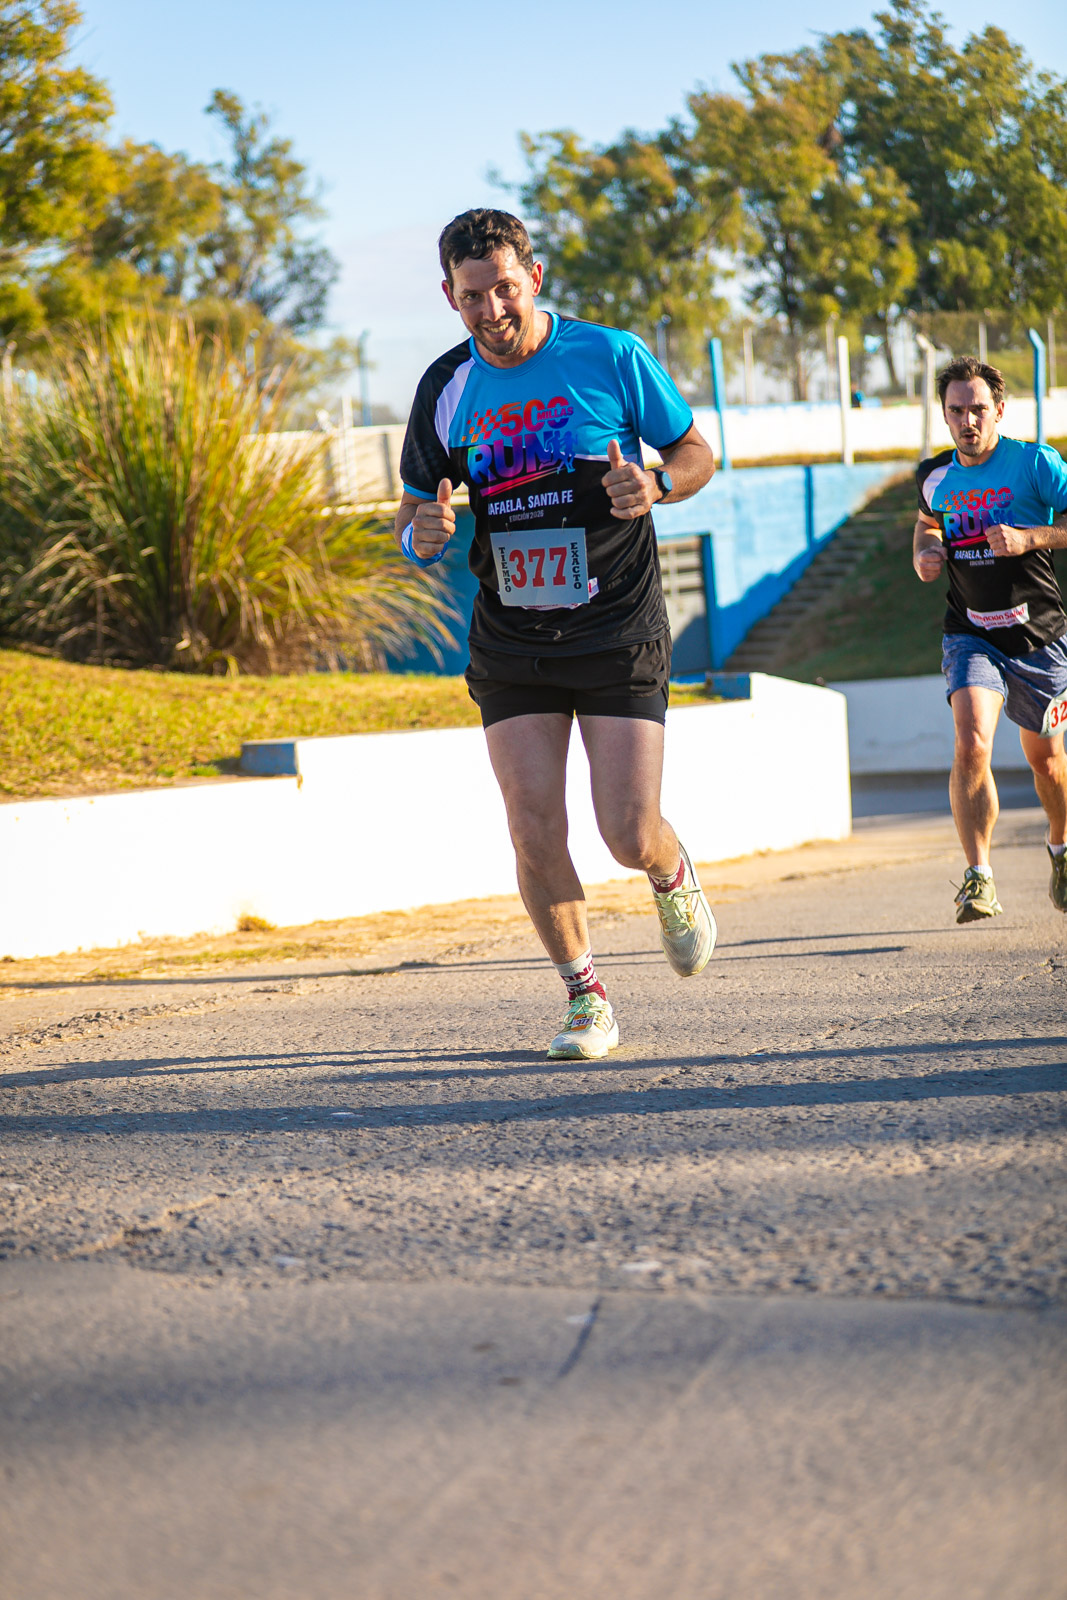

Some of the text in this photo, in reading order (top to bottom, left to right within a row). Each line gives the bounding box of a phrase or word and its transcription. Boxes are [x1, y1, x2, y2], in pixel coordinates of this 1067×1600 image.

[499, 396, 569, 437] 500
[537, 407, 574, 421] MILLAS
[467, 430, 556, 484] RUN
[528, 491, 559, 509] SANTA
[561, 489, 574, 503] FE
[967, 487, 1012, 511] 500
[498, 547, 512, 593] TIEMPO
[509, 547, 567, 588] 377
[570, 542, 582, 590] EXACTO
